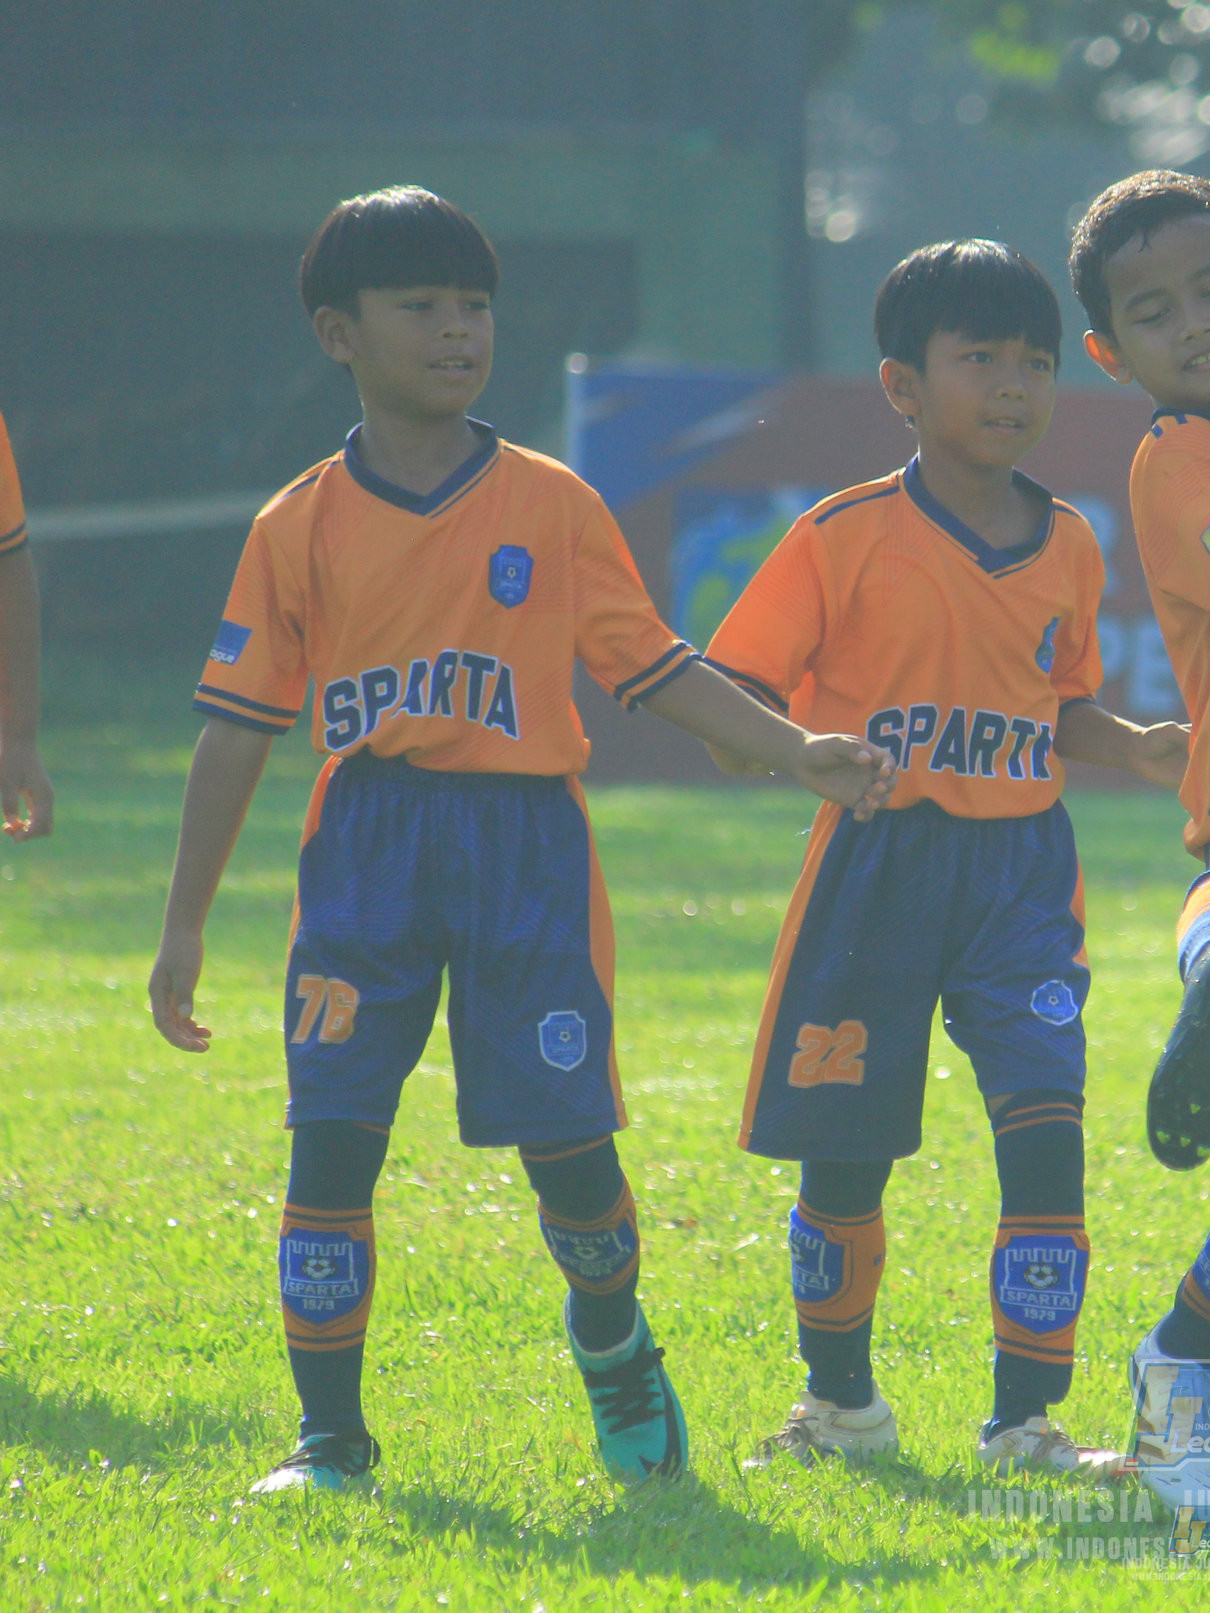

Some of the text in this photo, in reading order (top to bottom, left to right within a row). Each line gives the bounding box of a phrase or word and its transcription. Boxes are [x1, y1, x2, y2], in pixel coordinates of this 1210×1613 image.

[323, 648, 521, 752] SPARTA
[788, 1020, 868, 1088] 22
[288, 1280, 353, 1297] SPARTA
[303, 1298, 335, 1311] 1979
[1007, 1289, 1072, 1308] SPARTA
[1023, 1307, 1056, 1321] 1979
